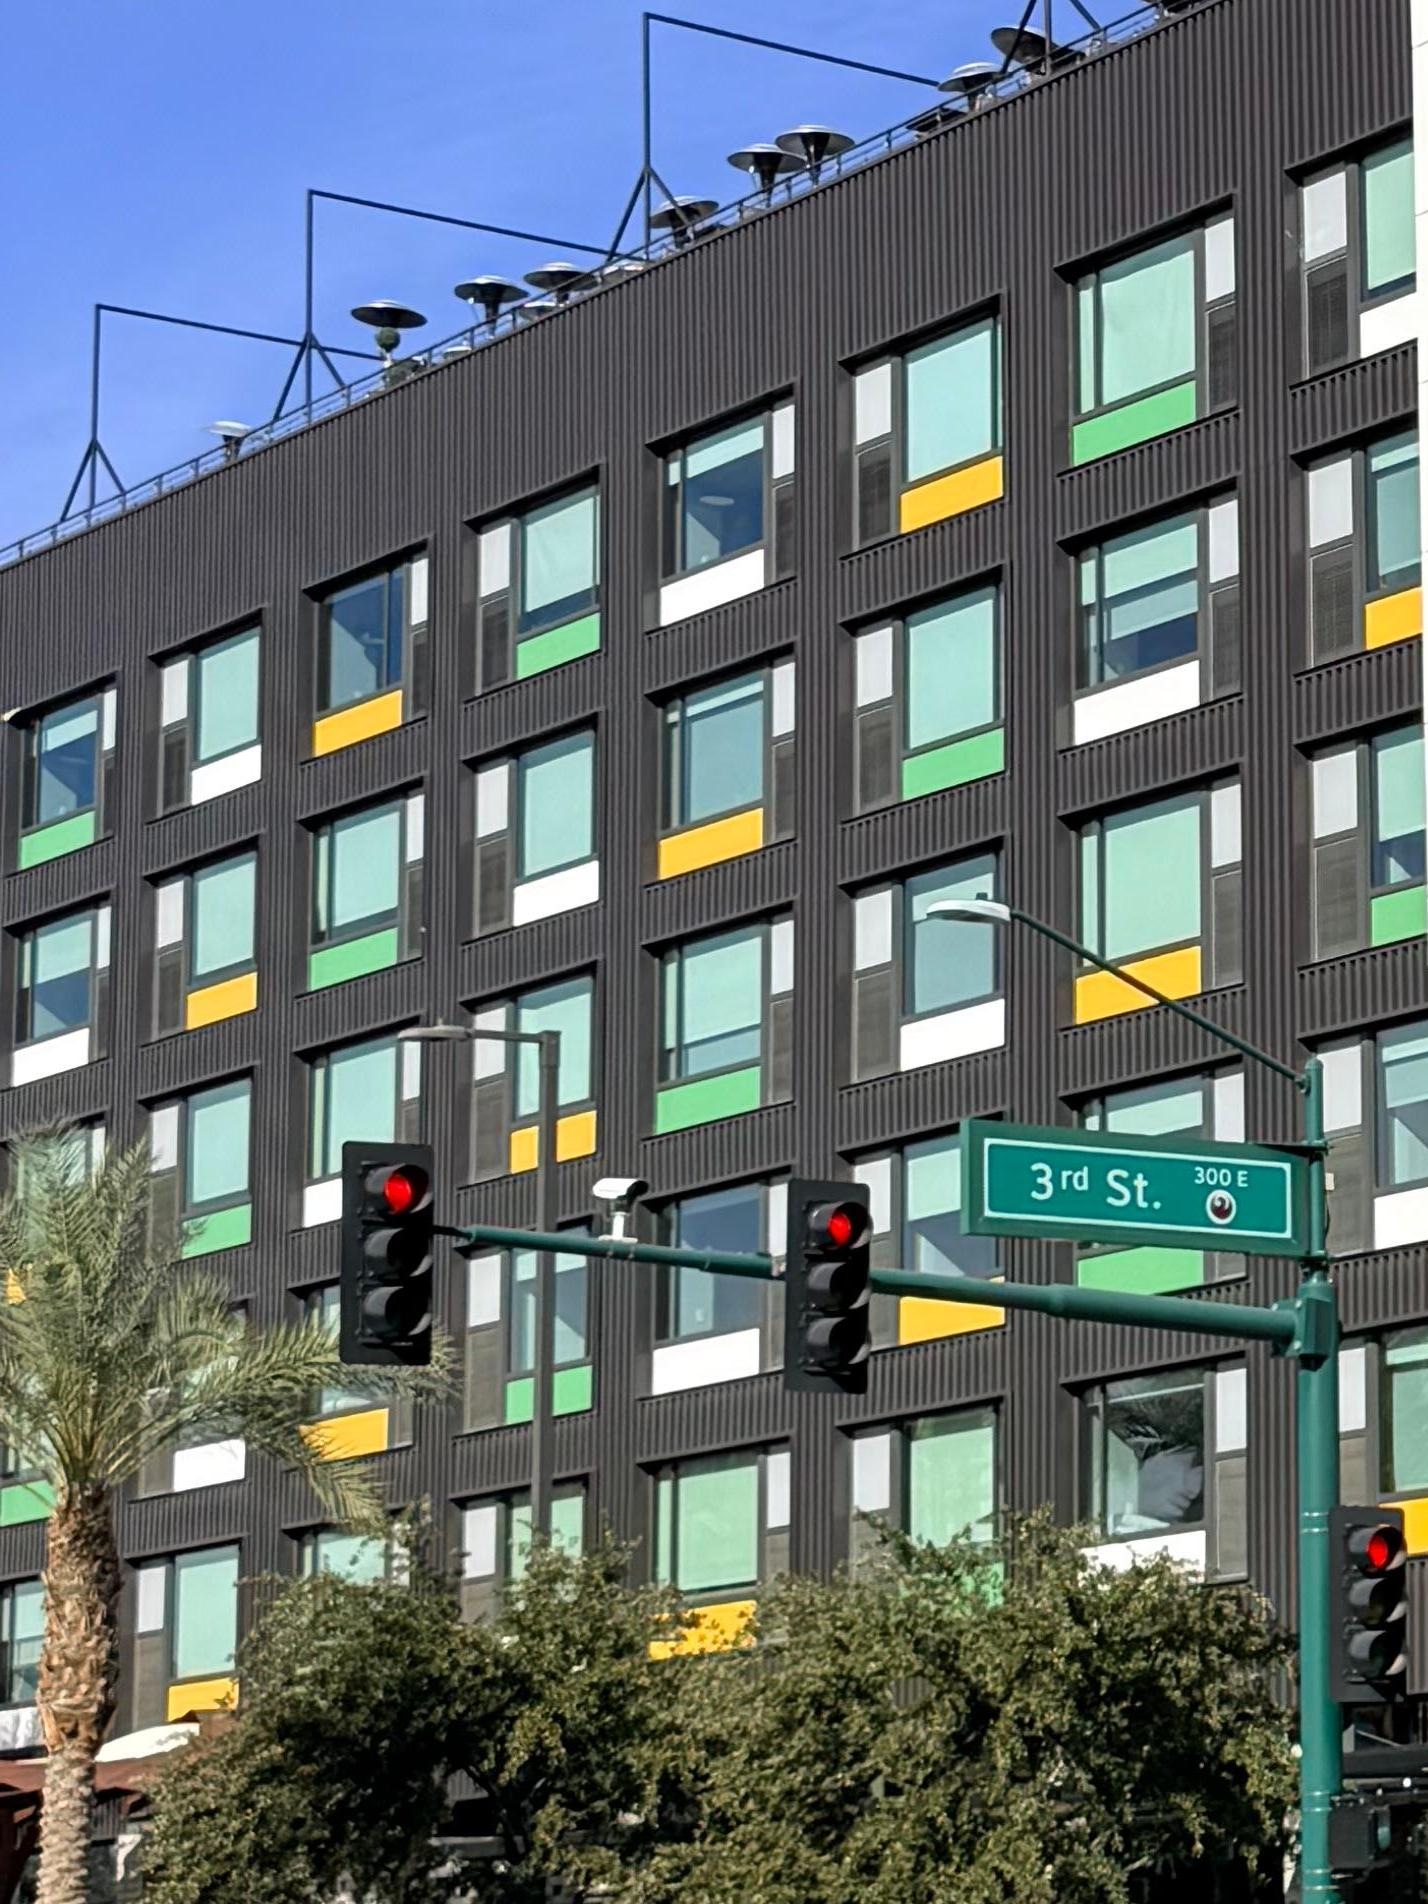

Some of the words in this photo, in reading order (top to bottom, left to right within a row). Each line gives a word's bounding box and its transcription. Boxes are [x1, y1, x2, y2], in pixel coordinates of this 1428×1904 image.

[1030, 1162, 1089, 1201] 3rd
[1106, 1168, 1162, 1210] St.
[1194, 1166, 1232, 1187] 300
[1236, 1170, 1248, 1187] E
